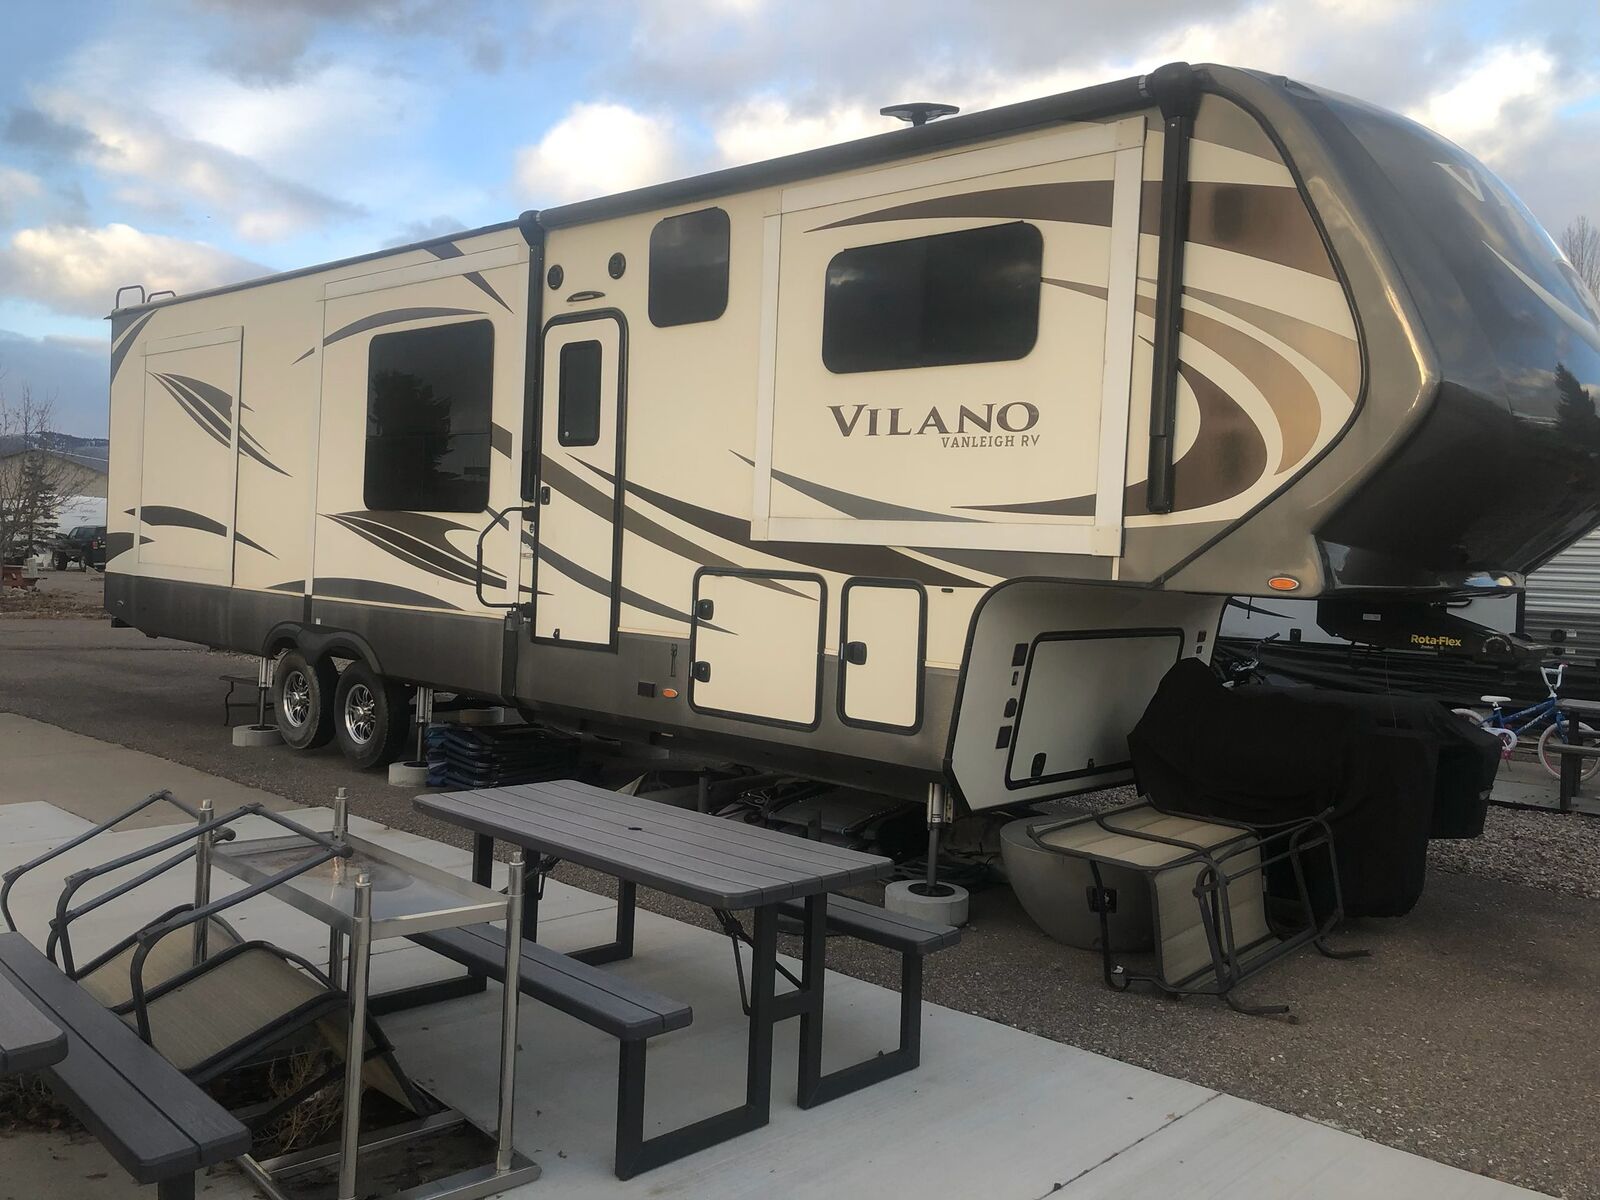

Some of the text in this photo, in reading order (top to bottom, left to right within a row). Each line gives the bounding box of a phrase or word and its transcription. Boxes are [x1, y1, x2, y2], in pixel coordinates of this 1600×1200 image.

[826, 401, 1040, 437] VILANO
[941, 434, 1040, 448] VANLEIGH RV
[1410, 634, 1462, 646] Rota-Flex
